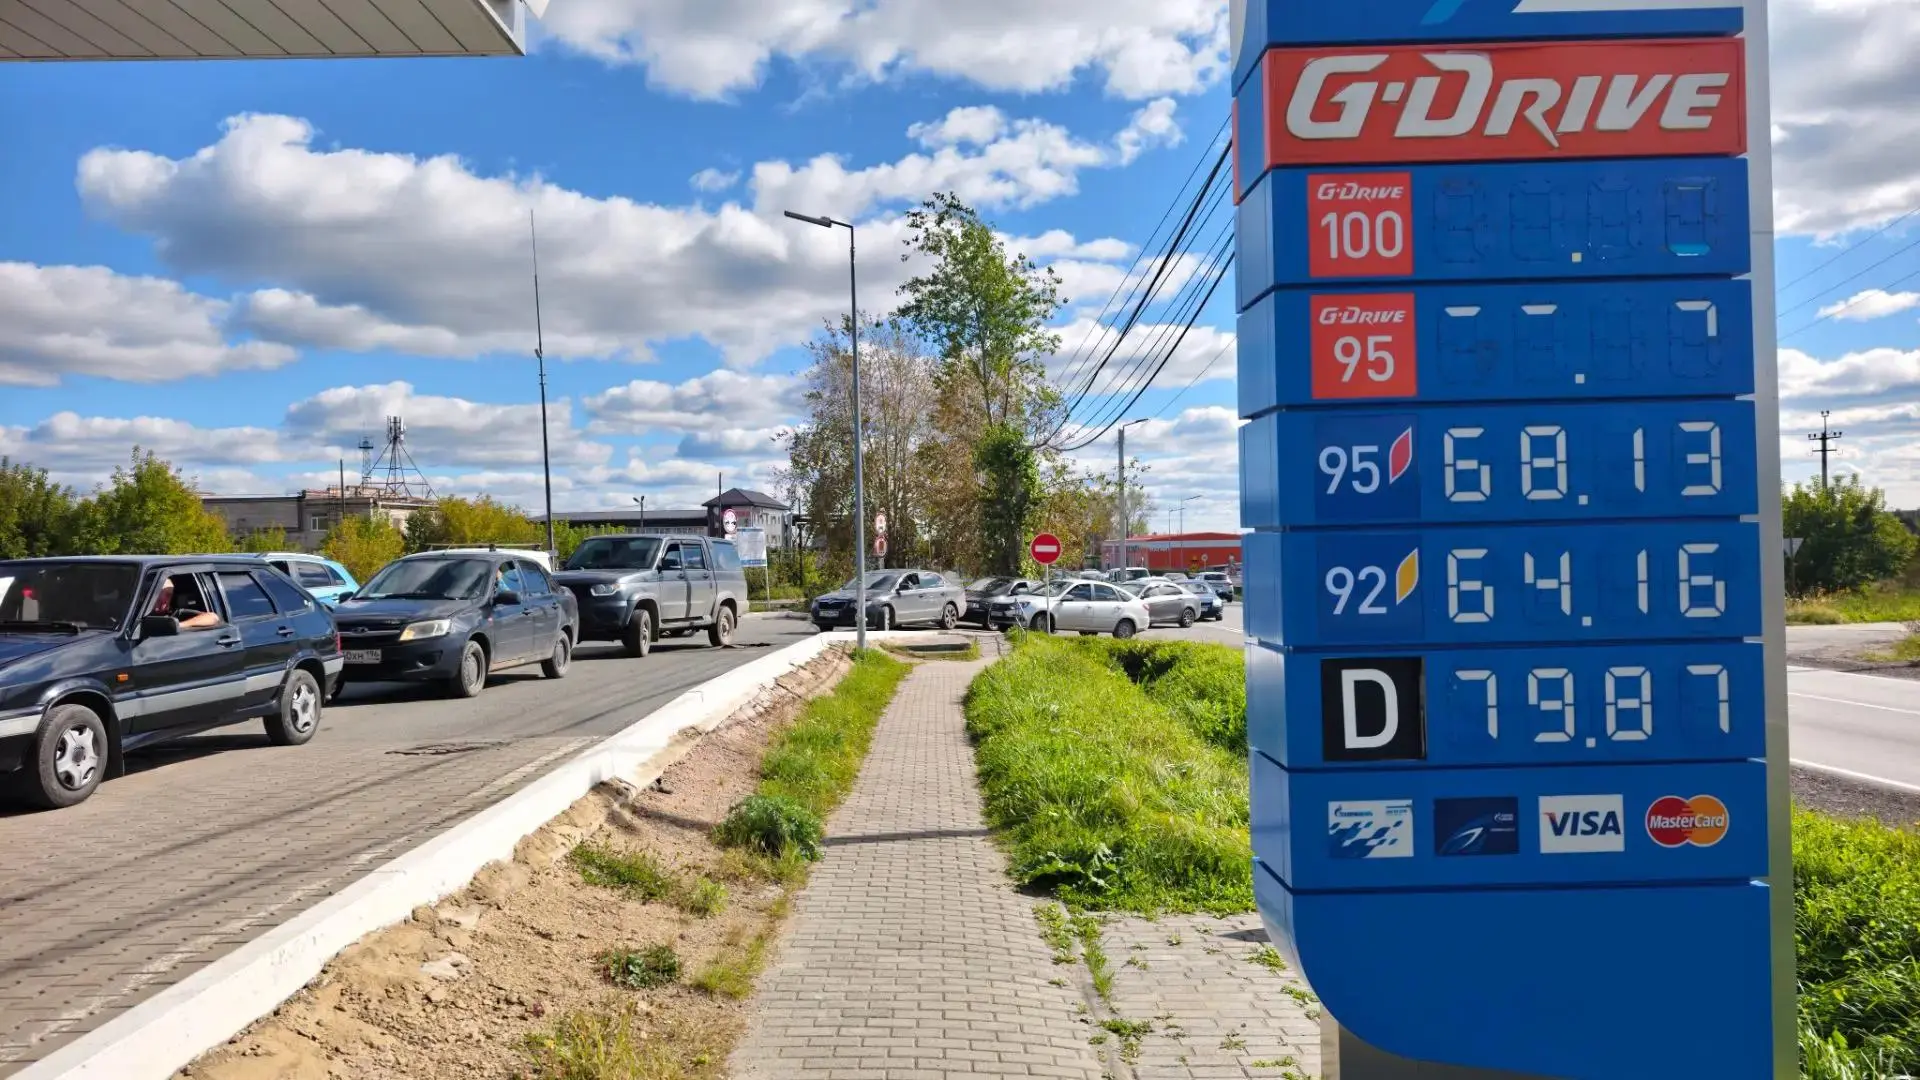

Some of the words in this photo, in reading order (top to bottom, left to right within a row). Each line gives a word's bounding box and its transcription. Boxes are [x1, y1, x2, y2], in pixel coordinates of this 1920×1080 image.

[1320, 210, 1403, 260] 100
[1333, 335, 1395, 382] 95
[1318, 445, 1380, 495] 95
[1443, 421, 1721, 504] 68.13
[1325, 565, 1388, 615] 92
[1447, 543, 1726, 626] 64.16
[1341, 668, 1399, 749] D
[1455, 664, 1730, 747] 79.87
[1543, 810, 1622, 837] VISA
[1649, 813, 1726, 830] MasterCard
